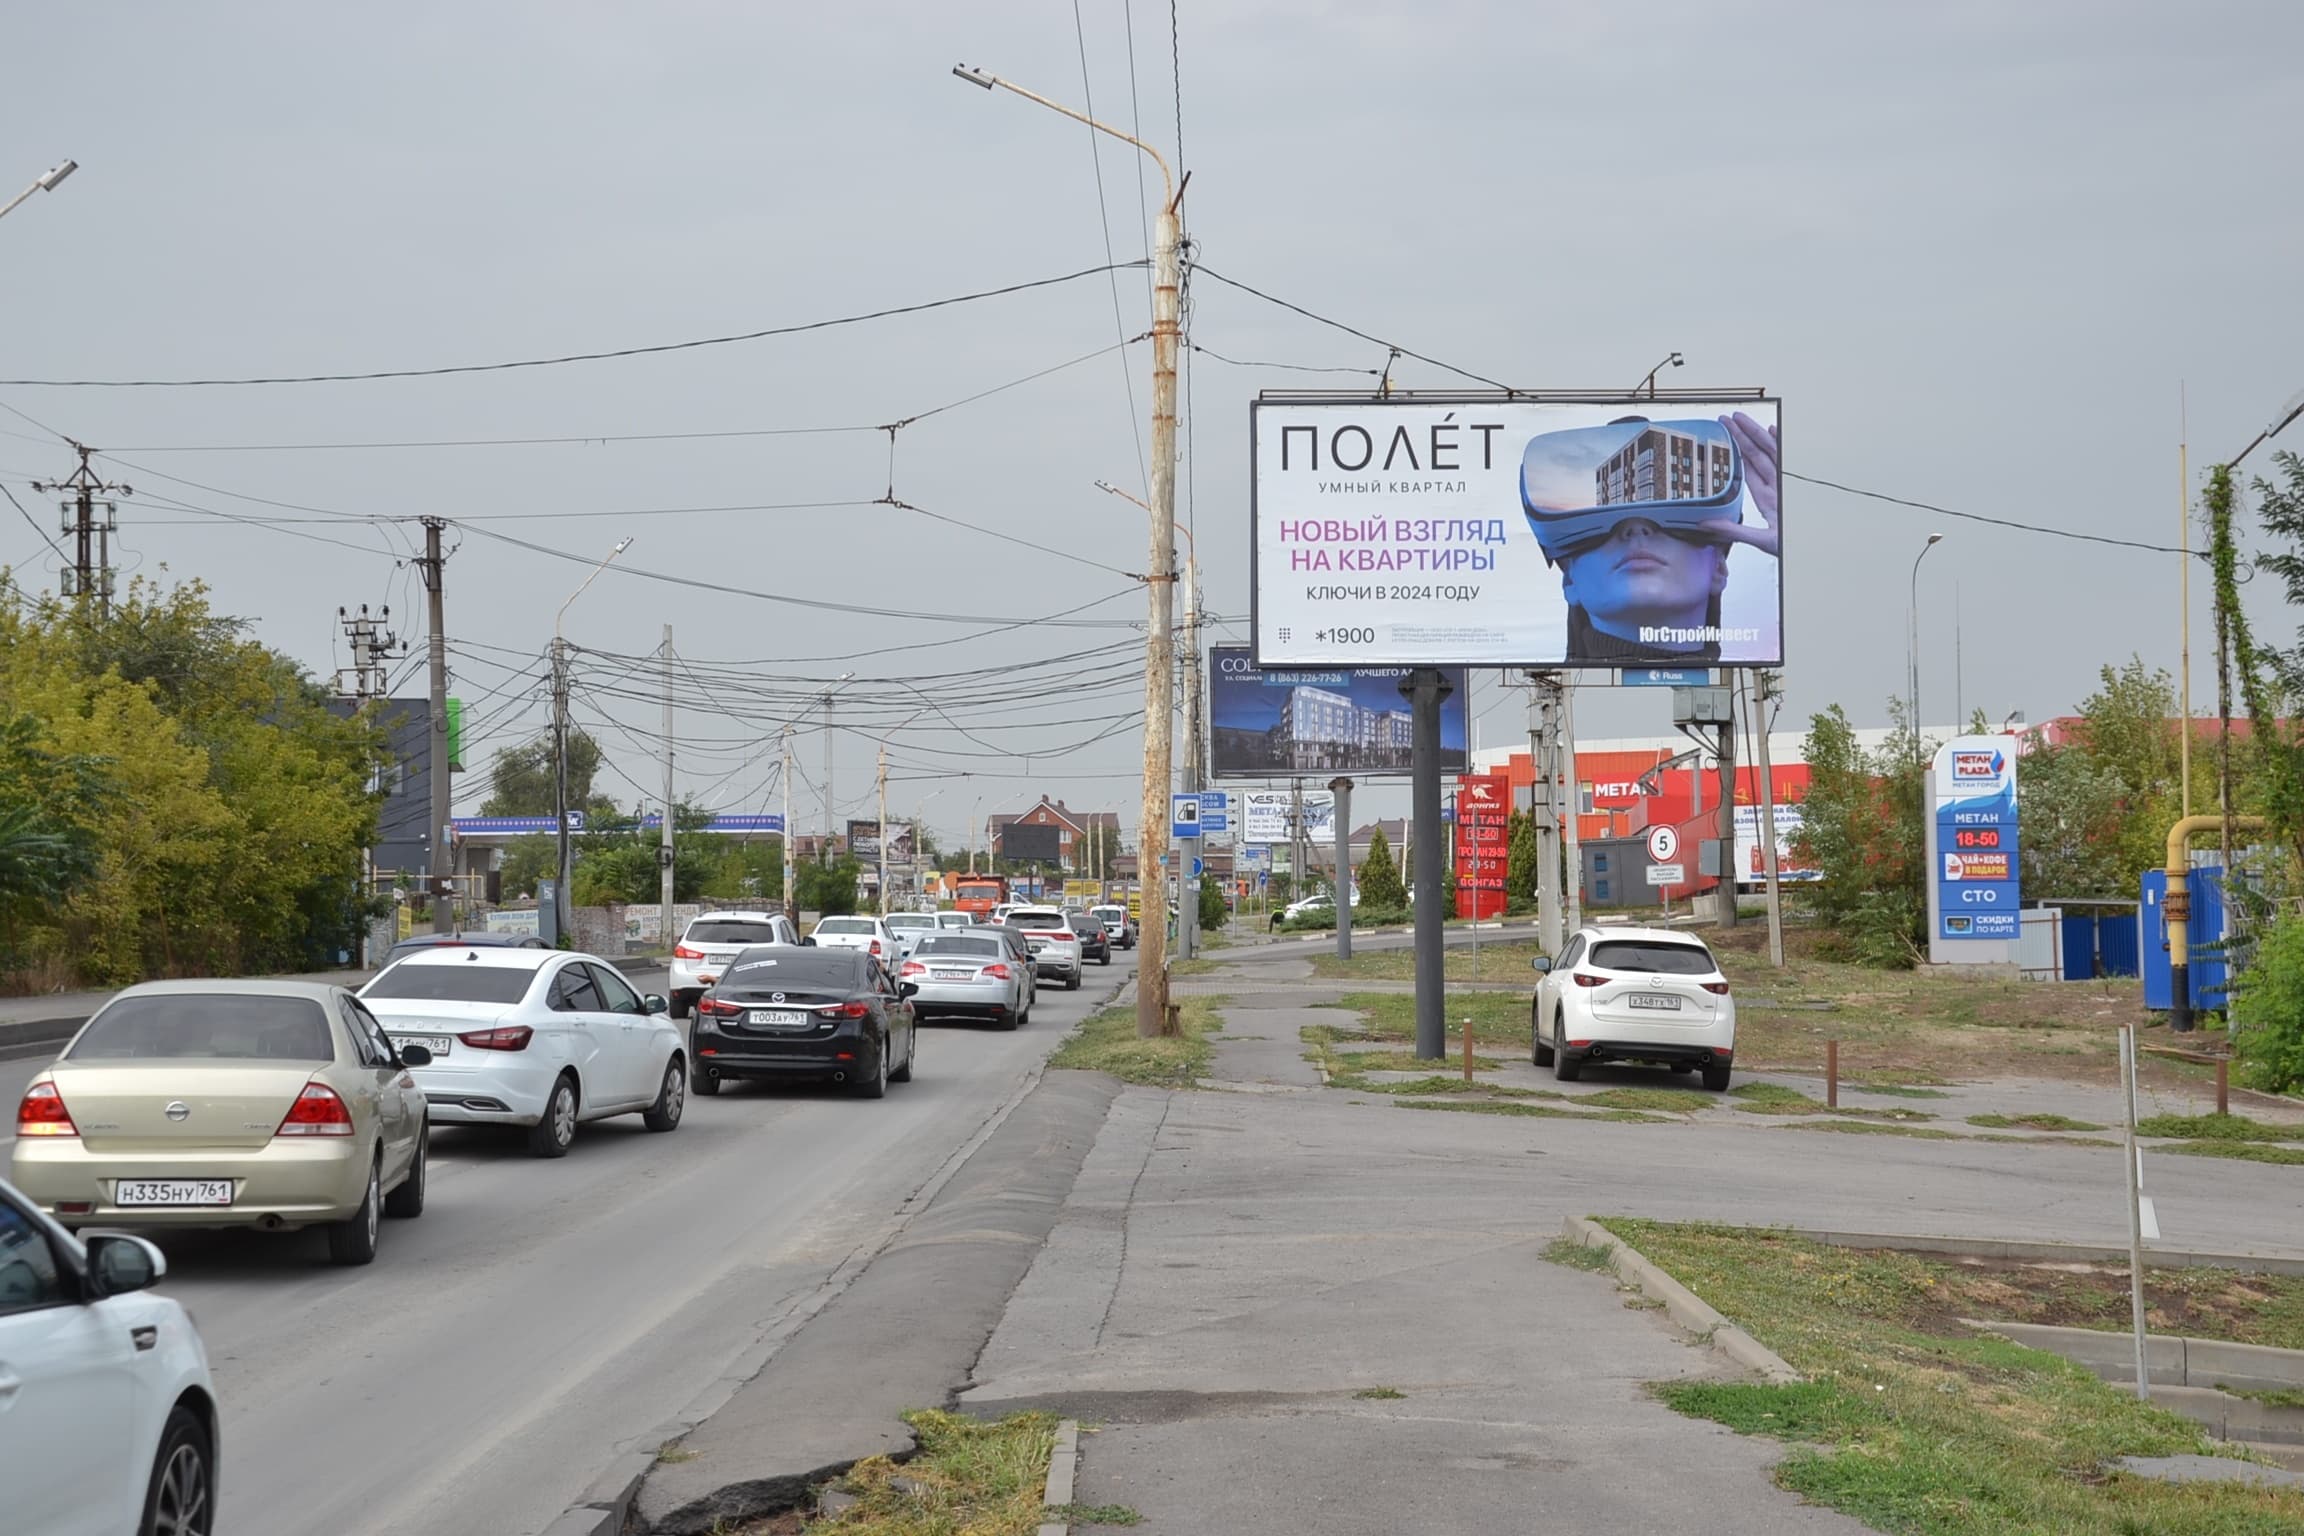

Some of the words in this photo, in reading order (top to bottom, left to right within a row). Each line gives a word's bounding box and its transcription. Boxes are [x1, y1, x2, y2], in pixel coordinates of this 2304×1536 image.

[1318, 480, 1382, 494] УМНЫЙ
[1388, 480, 1467, 493] КВАРТАЛ
[1280, 514, 1388, 542] НОВЫЙ
[1394, 519, 1507, 546] ВЗГЛЯД
[1291, 549, 1332, 572] НА
[1338, 548, 1495, 572] КВАРТИРЫ
[1306, 585, 1372, 601] КЛЮЧИ
[1375, 586, 1387, 600] В
[1390, 585, 1432, 600] 2024
[1435, 585, 1480, 602] ГОДУ
[1639, 626, 1760, 644] ЮгСтройИнвест
[1269, 673, 1276, 683] 8
[1277, 672, 1299, 684] (863)
[1301, 672, 1342, 684] 226-77-26
[1958, 766, 1991, 776] PLAZA
[1954, 813, 1999, 824] МЕТАН
[1658, 835, 1669, 852] 5
[1955, 831, 1998, 847] 18-50
[1962, 889, 1997, 903] СТО
[1976, 915, 2015, 925] СКИДКИ
[1976, 925, 1988, 933] ПО
[1990, 925, 2015, 933] КАРТЕ
[429, 1038, 447, 1049] 761
[123, 1184, 194, 1201] Н335НУ
[200, 1183, 227, 1197] 761
